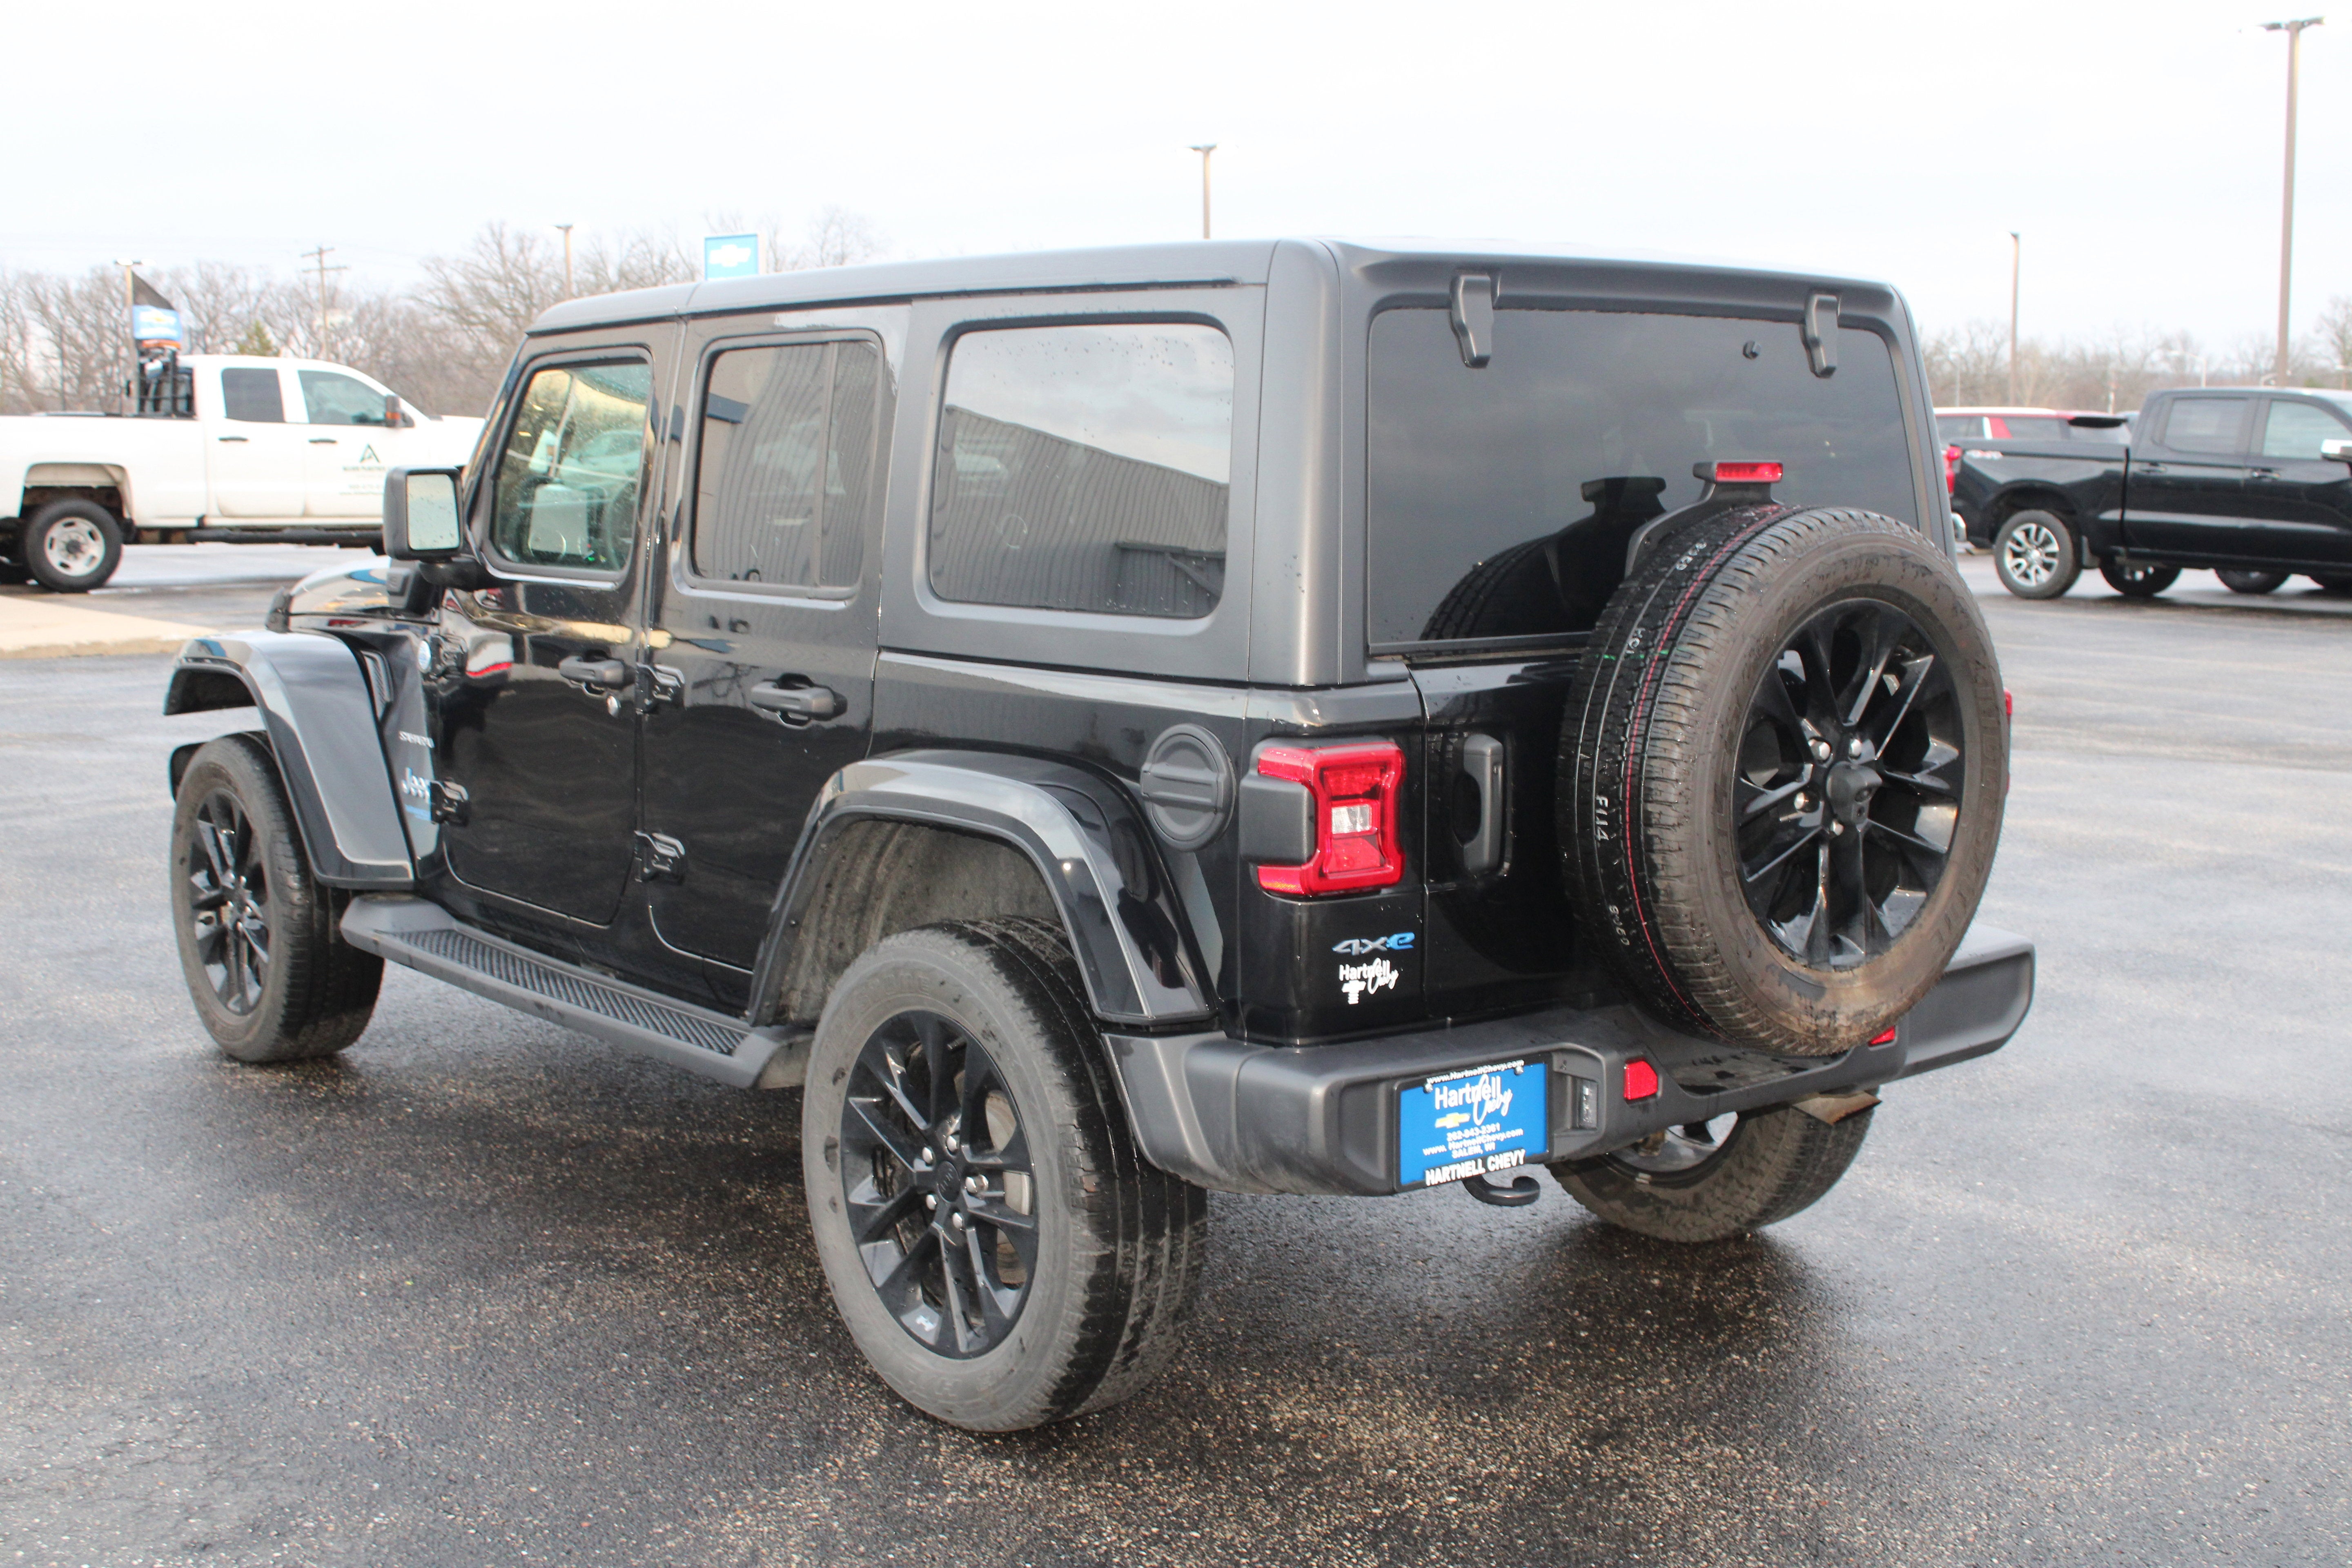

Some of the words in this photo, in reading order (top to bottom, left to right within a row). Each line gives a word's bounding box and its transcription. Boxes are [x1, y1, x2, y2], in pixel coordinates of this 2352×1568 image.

[1339, 960, 1391, 981] Hartnell
[1426, 1059, 1525, 1084] www.HartnellChevy.com
[1434, 1075, 1501, 1110] Hartnell
[1448, 1128, 1524, 1150] HartnellChevy.com
[1452, 1145, 1483, 1159] SALEM,
[1484, 1142, 1496, 1152] WI
[1425, 1158, 1486, 1186] HARTNELL
[1487, 1148, 1526, 1172] CHEVY
